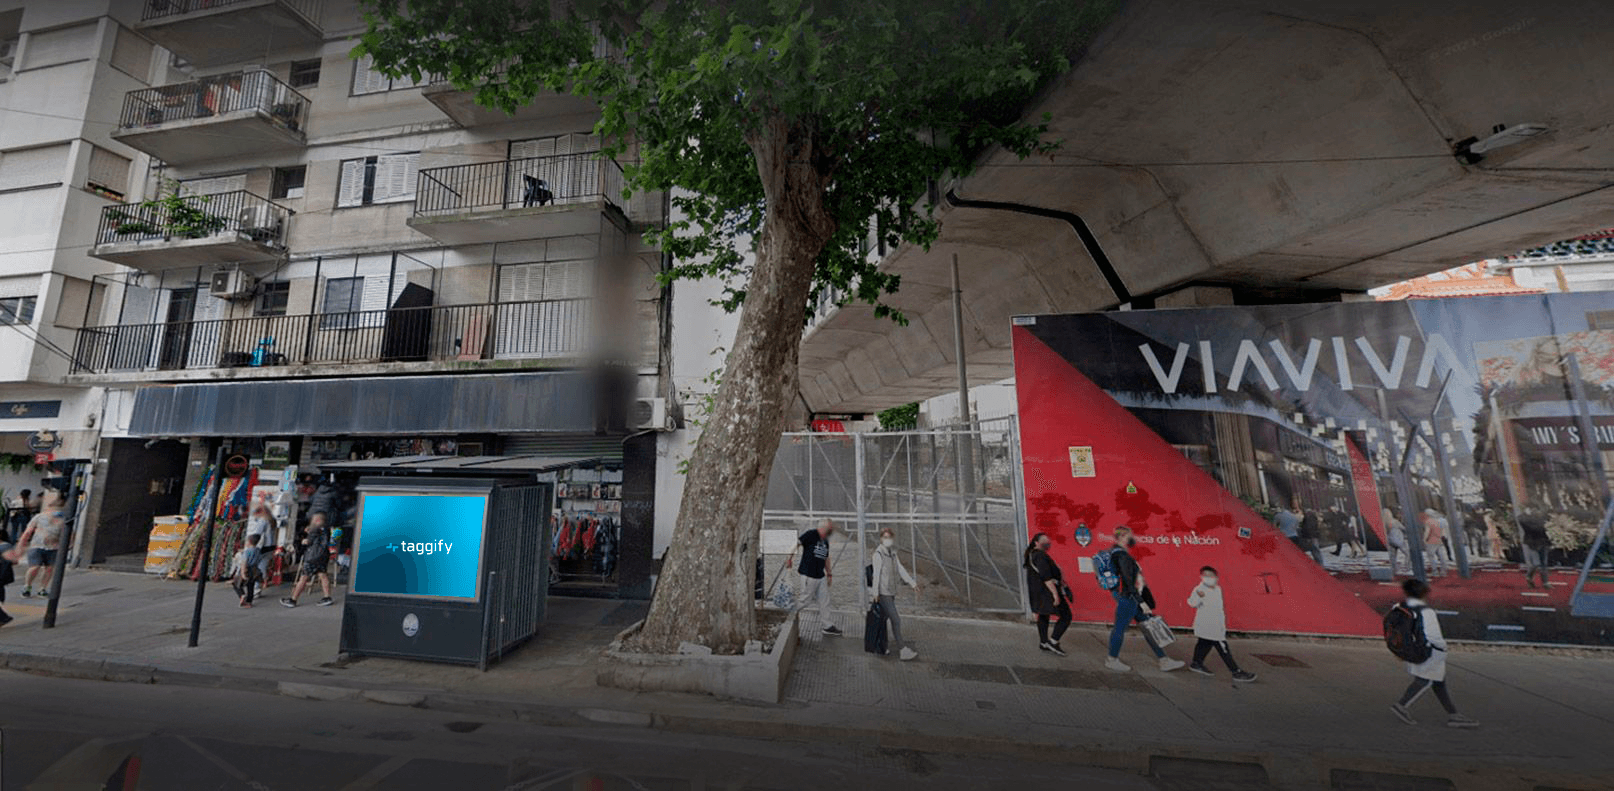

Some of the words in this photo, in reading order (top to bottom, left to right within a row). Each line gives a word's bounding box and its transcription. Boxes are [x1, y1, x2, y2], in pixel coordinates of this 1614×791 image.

[1138, 333, 1474, 393] VIAVIVA
[399, 539, 453, 555] taggify
[1156, 534, 1169, 544] de
[1184, 534, 1220, 545] Nación
